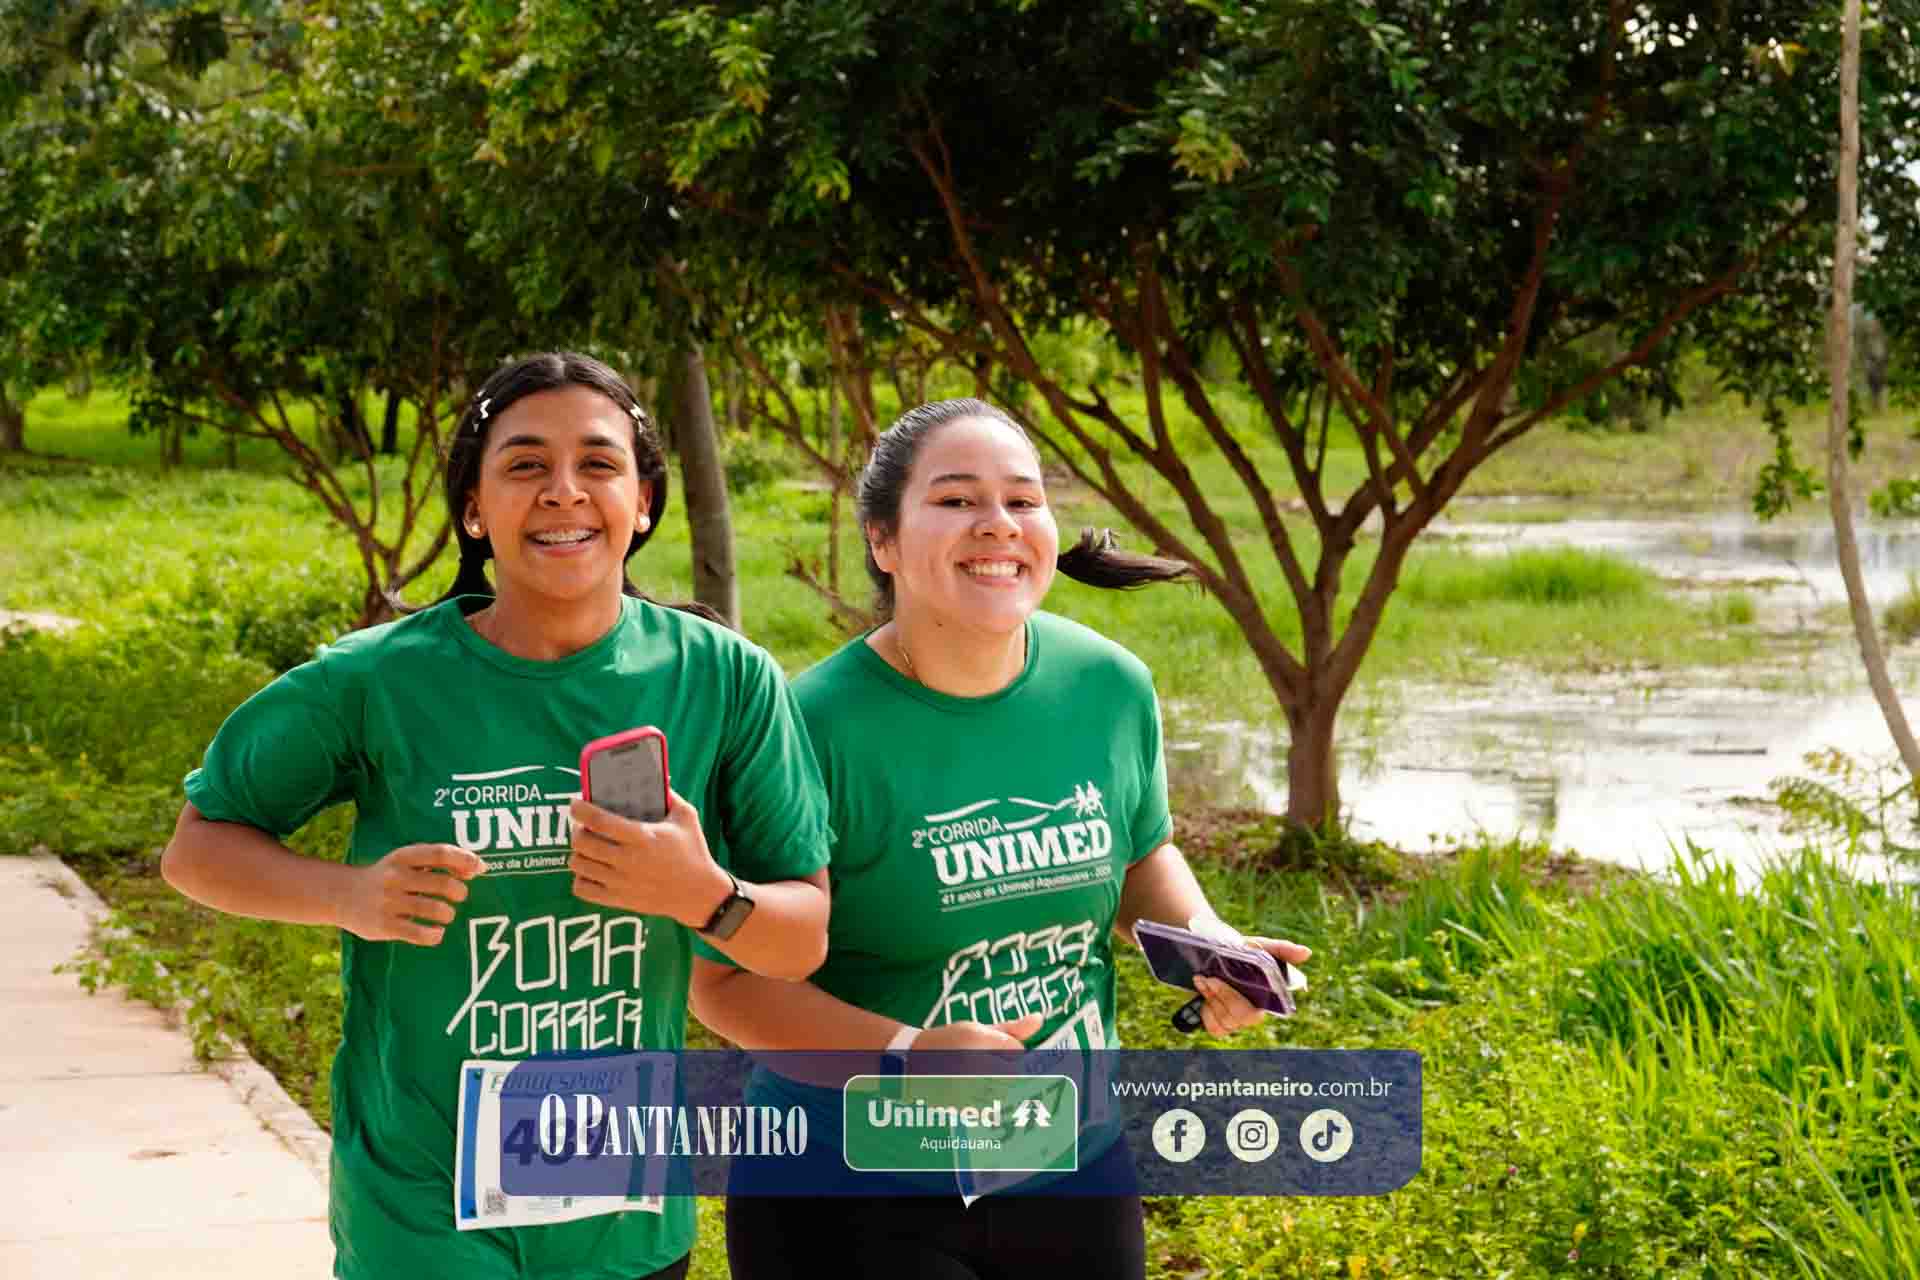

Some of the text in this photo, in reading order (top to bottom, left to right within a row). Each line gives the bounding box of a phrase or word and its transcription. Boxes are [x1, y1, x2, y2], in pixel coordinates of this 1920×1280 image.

[451, 783, 542, 806] CORRIDA
[927, 815, 1003, 845] CORRIDA
[930, 818, 1113, 886] UNIMED
[523, 855, 566, 869] Unimed
[446, 913, 642, 1036] BORA
[470, 990, 643, 1056] CORRER
